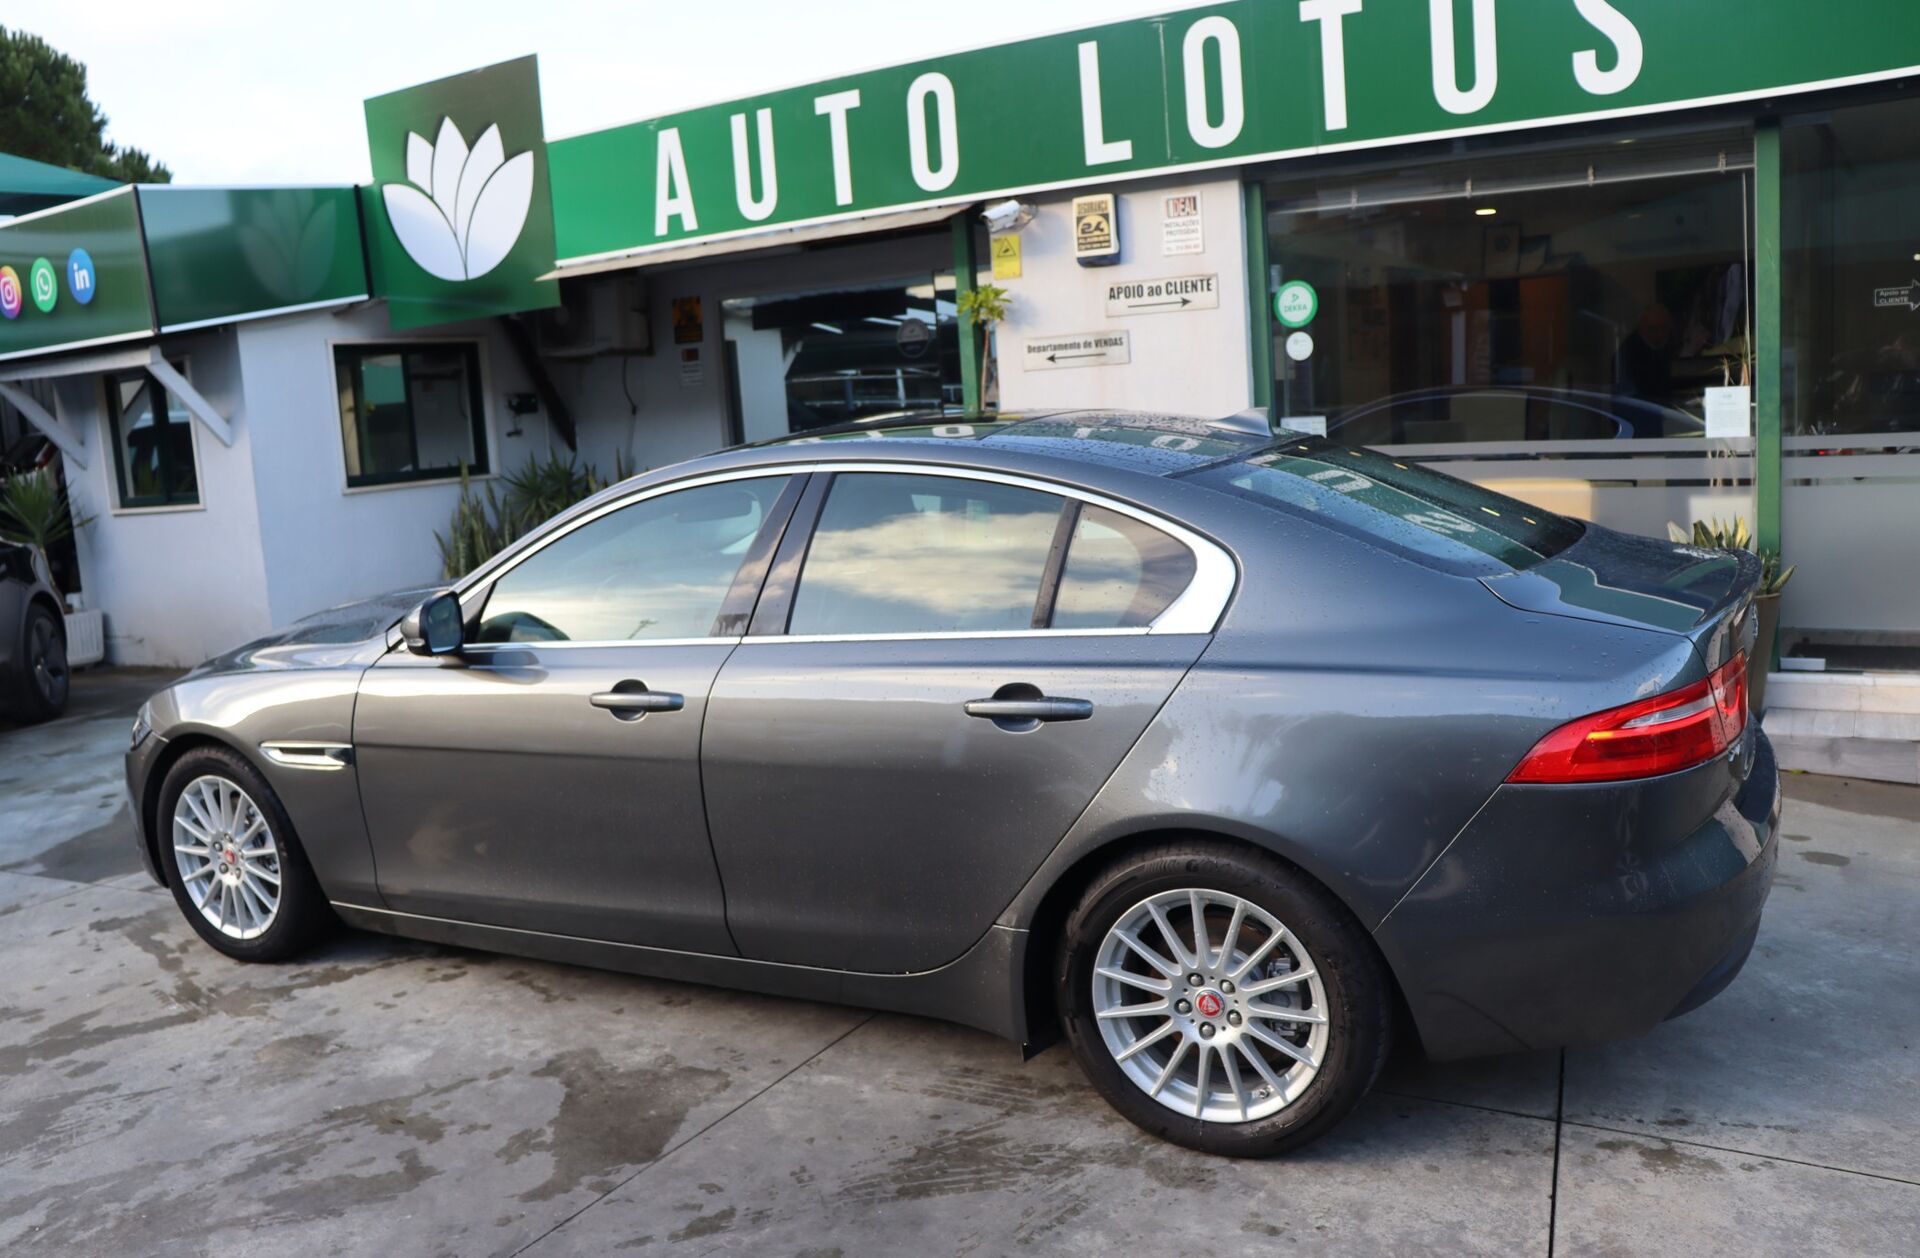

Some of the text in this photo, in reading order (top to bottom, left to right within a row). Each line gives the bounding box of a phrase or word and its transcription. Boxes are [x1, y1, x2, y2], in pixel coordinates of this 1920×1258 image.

[655, 0, 1643, 236] AUTO LOTUS
[1166, 196, 1198, 218] IDEAL
[1109, 278, 1212, 300] APOIO ao CLIENTE
[1027, 337, 1123, 354] Departamento de VENDAS
